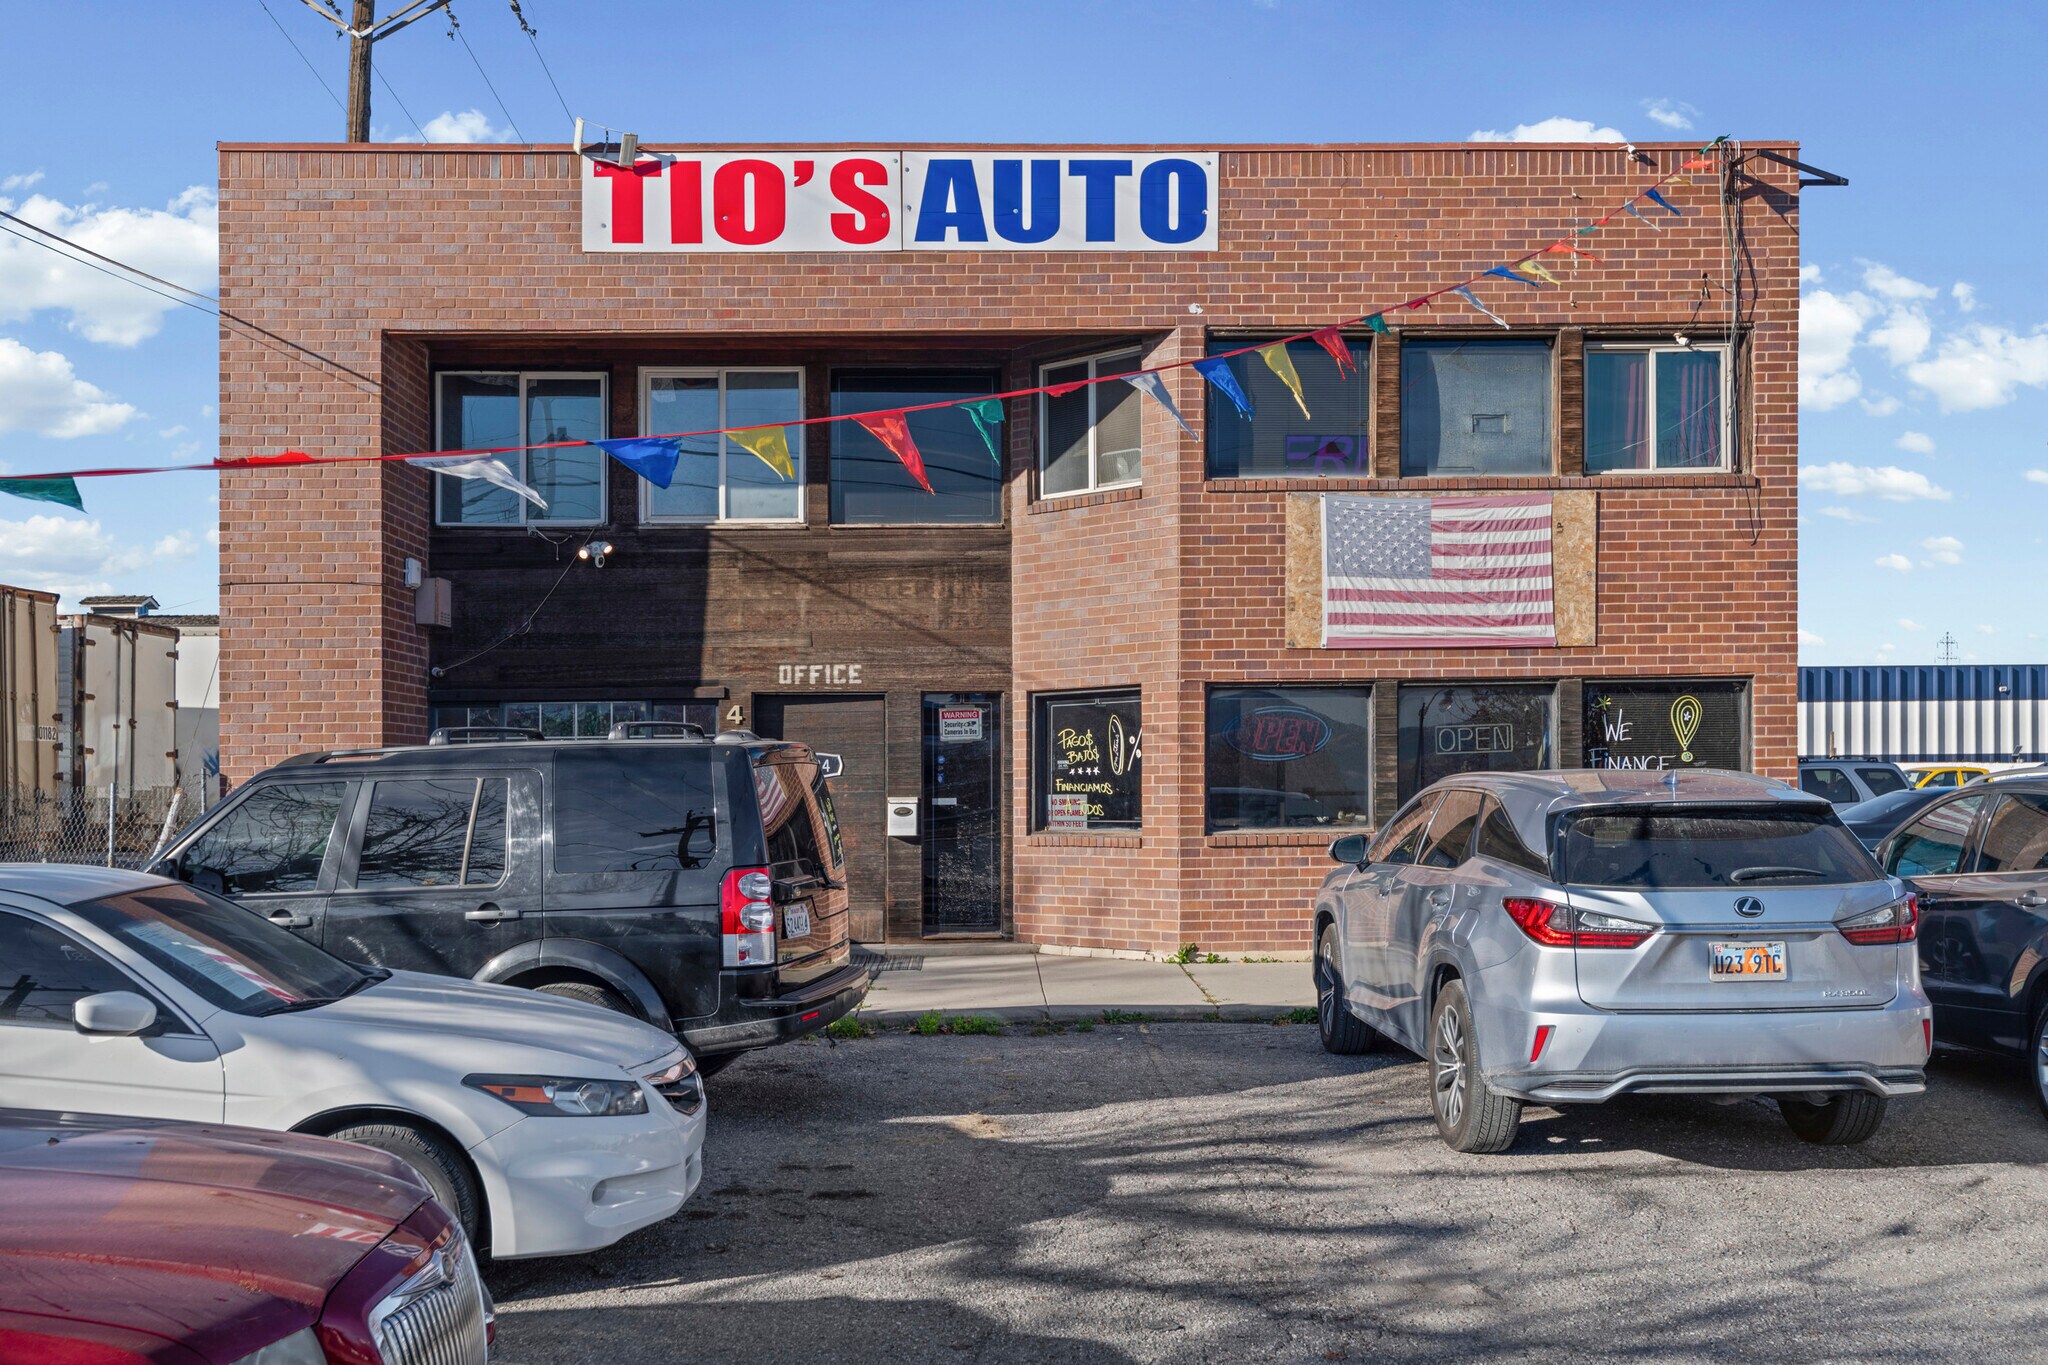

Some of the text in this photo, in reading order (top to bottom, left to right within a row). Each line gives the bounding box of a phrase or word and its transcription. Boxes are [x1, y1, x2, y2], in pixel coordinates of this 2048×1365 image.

[593, 158, 1208, 246] TIO'S AUTO
[778, 664, 862, 685] OFFICE
[726, 705, 743, 725] 4
[943, 711, 978, 719] WARNING
[1602, 708, 1633, 742] WE
[1239, 716, 1321, 755] OPEN
[1438, 725, 1510, 752] OPEN
[1055, 778, 1114, 795] FINANCIAMOS
[1715, 955, 1781, 974] U23 9TC
